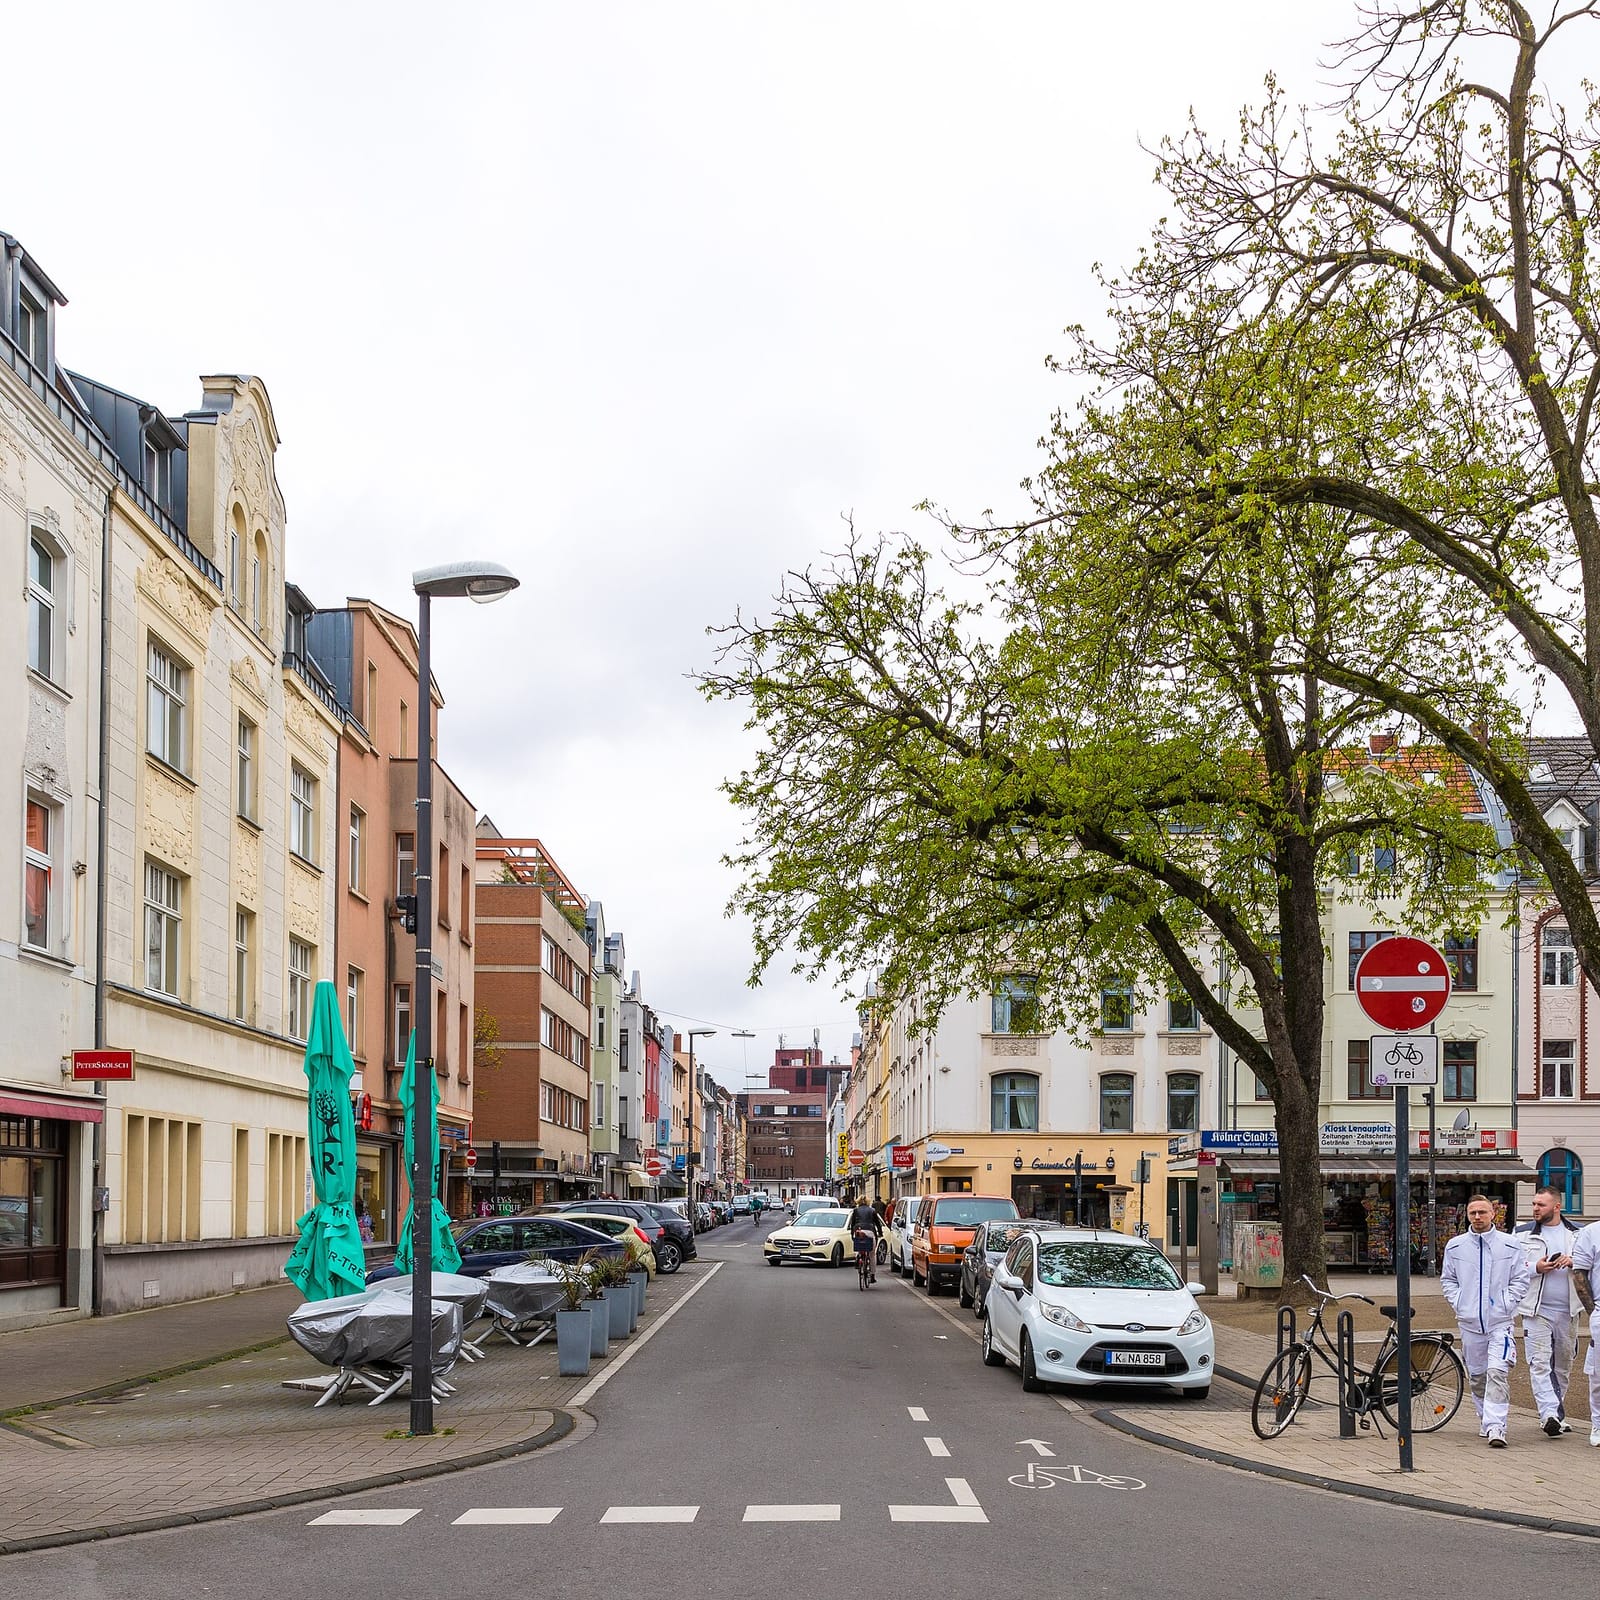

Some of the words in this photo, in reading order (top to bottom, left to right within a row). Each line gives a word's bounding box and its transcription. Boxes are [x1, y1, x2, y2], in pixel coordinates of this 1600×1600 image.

[1394, 1068, 1415, 1079] frei
[1348, 1125, 1391, 1134] Lenauplatz
[1115, 1353, 1122, 1363] K
[1128, 1354, 1141, 1364] NA
[1143, 1354, 1161, 1364] 858
